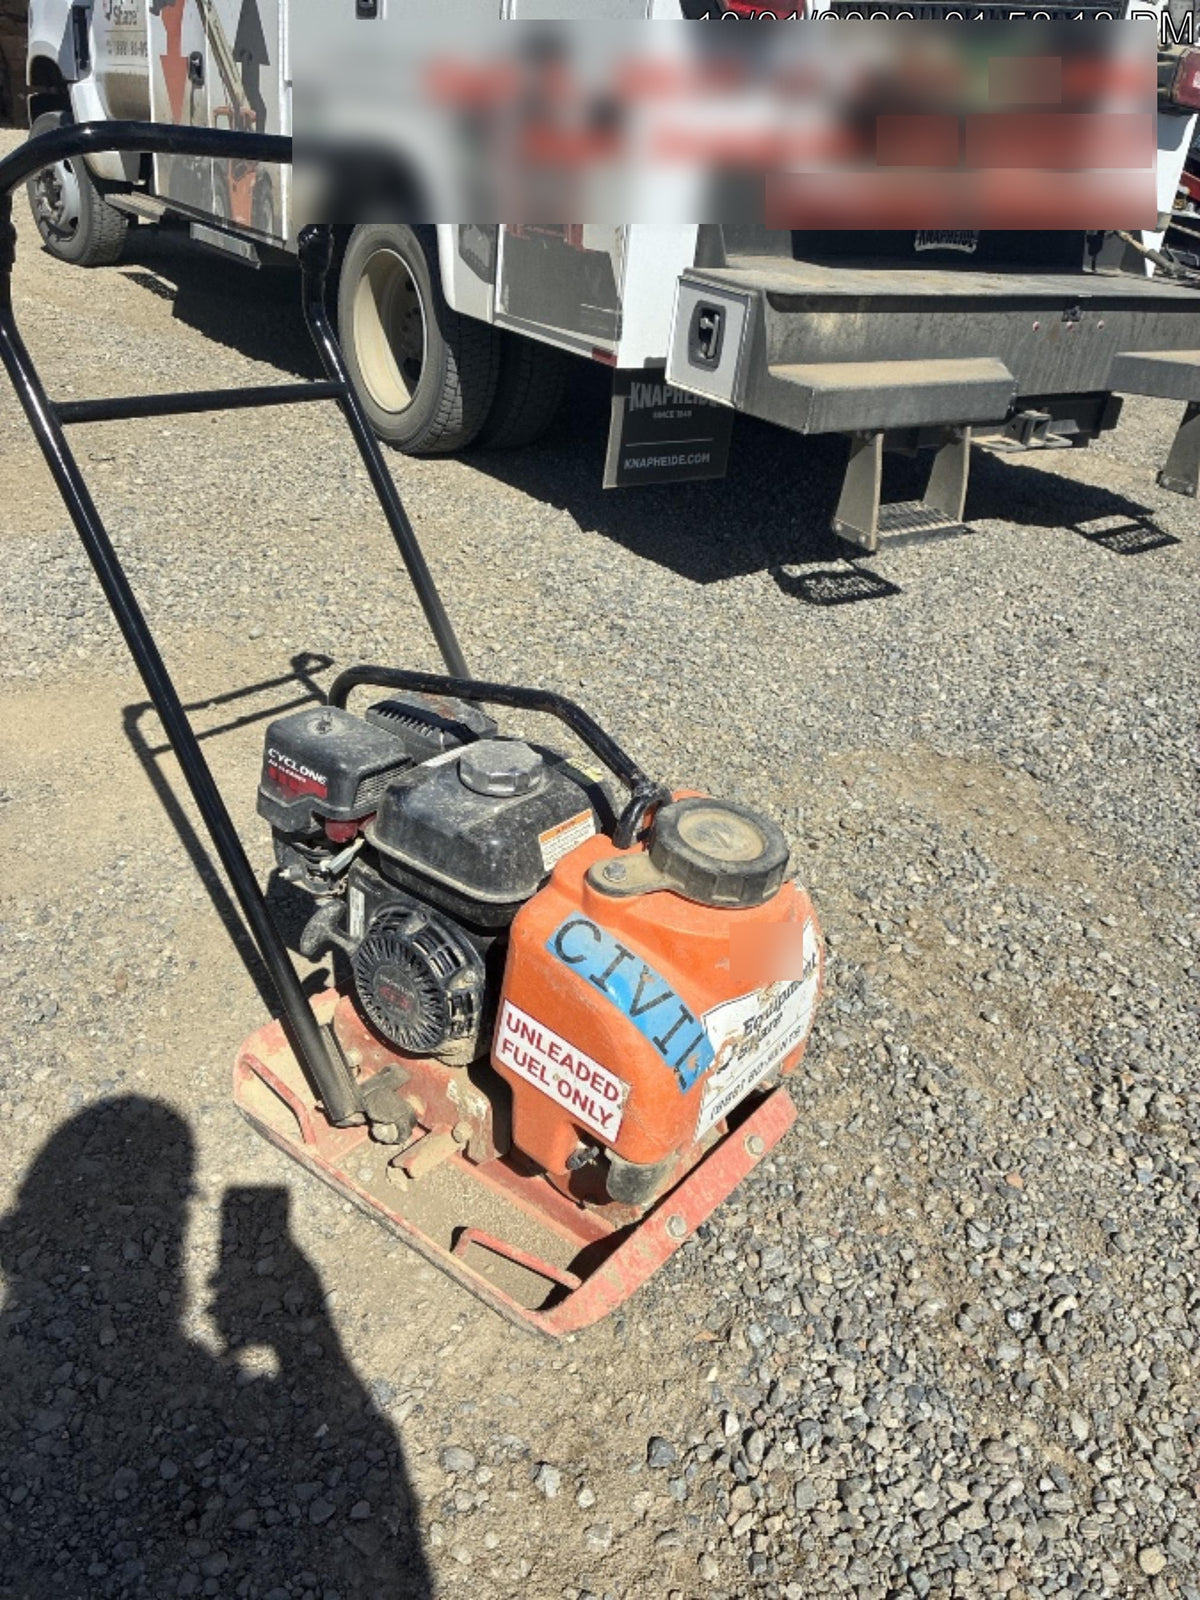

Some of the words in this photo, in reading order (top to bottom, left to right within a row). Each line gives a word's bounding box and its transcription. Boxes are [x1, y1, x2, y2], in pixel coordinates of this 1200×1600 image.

[629, 381, 722, 411] KNAPHEI
[624, 453, 710, 470] KNAPHEIDE.COM
[268, 748, 327, 787] CYCLONE
[555, 919, 704, 1089] CIVIL
[502, 1038, 550, 1086] FUEL
[557, 1080, 614, 1128] ONLY
[506, 1012, 619, 1101] UNLEADED
